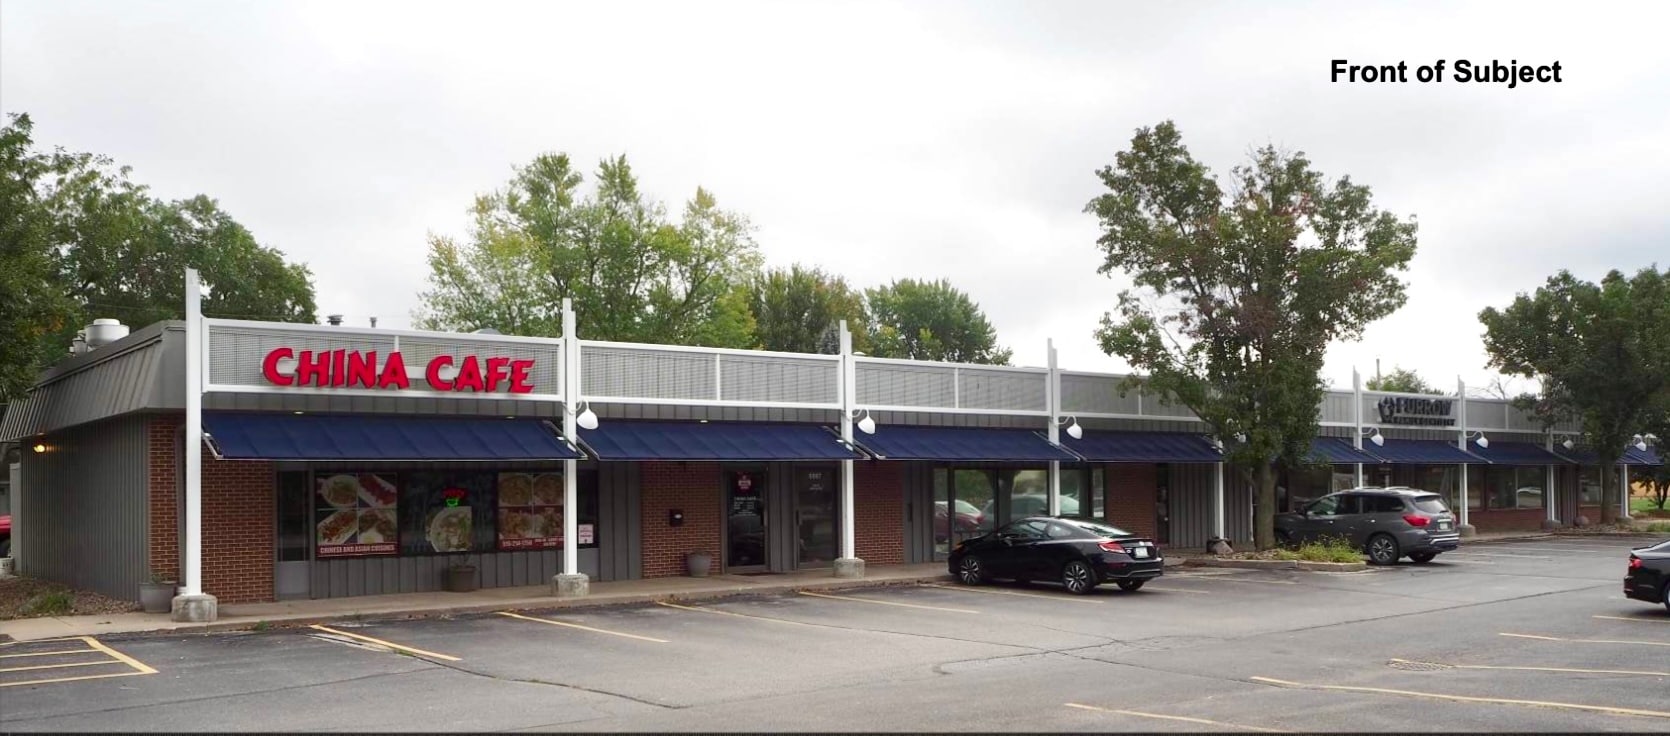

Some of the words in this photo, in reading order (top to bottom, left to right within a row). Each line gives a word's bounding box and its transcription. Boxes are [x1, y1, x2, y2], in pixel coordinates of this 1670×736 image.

[262, 347, 410, 389] CHINA
[425, 355, 535, 394] CAFE
[1395, 397, 1452, 416] FURROW
